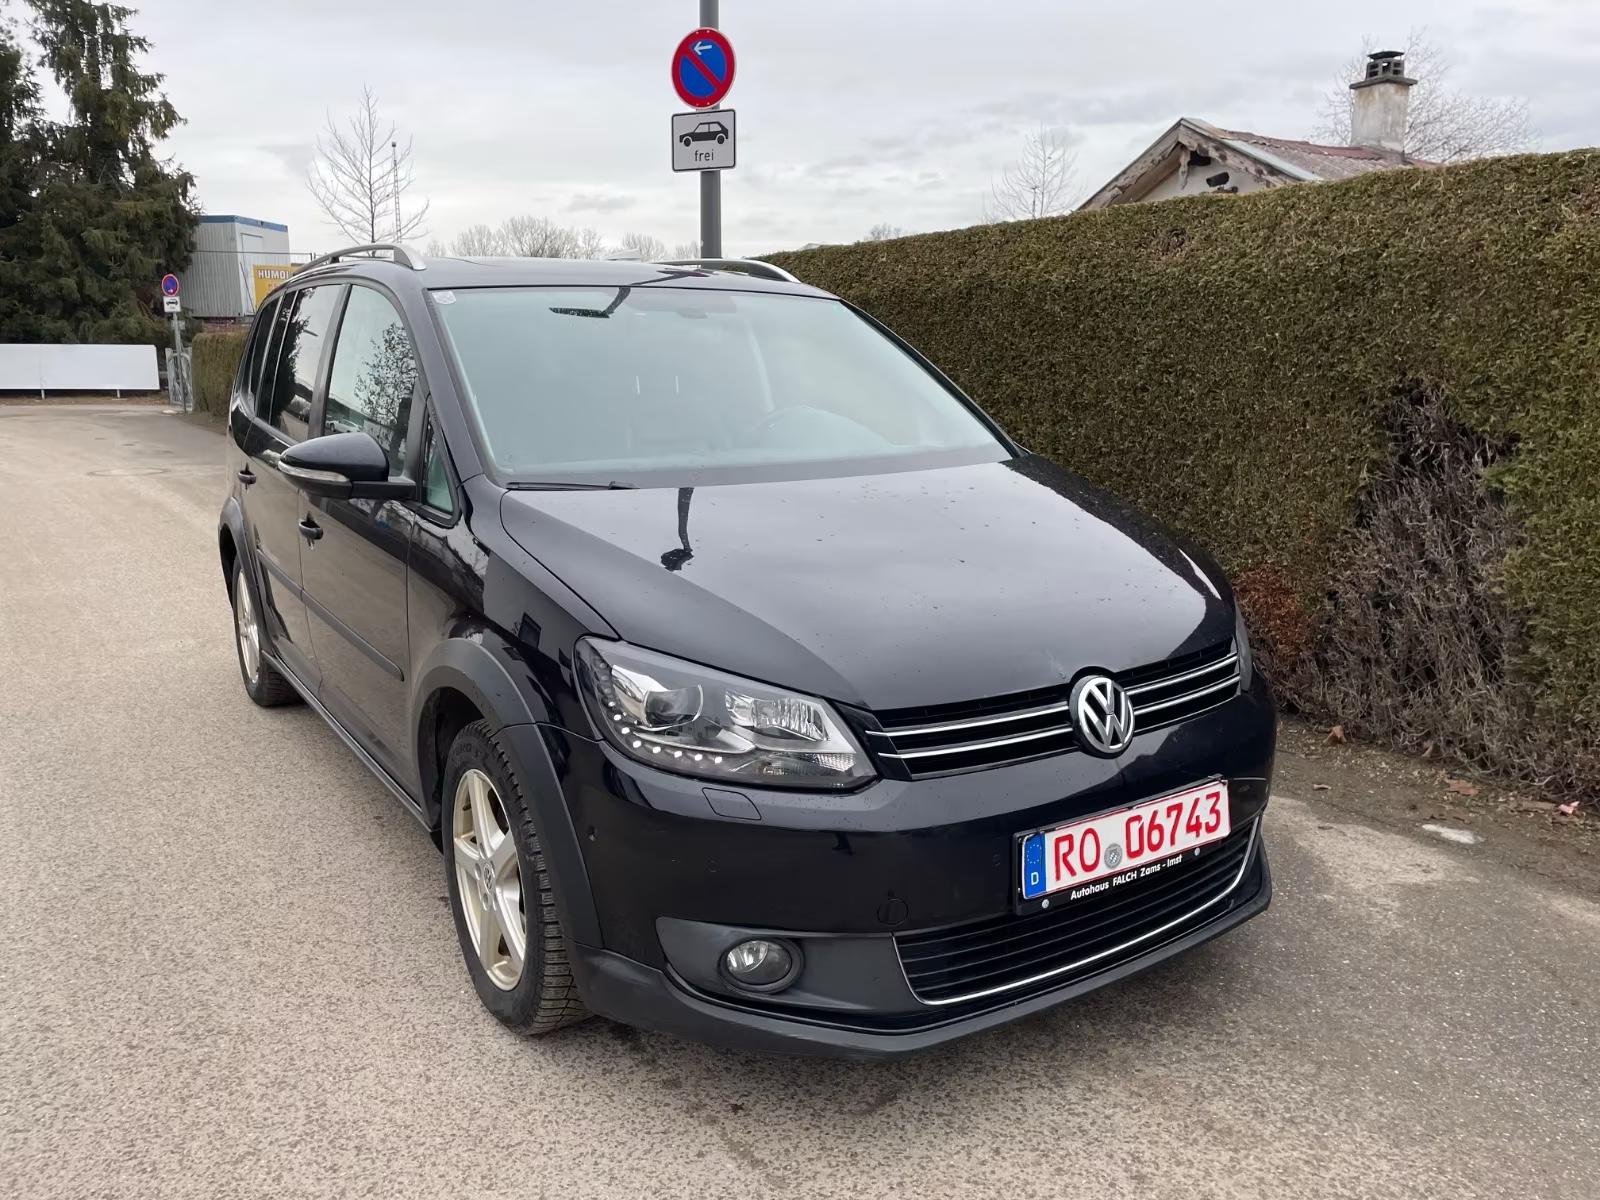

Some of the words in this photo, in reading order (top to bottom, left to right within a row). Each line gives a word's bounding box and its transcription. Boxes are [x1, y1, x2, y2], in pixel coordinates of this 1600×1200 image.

[694, 149, 714, 162] frei
[1079, 677, 1133, 750] VW
[1054, 827, 1101, 881] RO
[1125, 790, 1221, 859] 06743
[1030, 871, 1040, 886] D
[1070, 881, 1110, 900] Autohaus
[1112, 870, 1138, 886] FALCH
[1140, 863, 1161, 878] Zams
[1167, 854, 1183, 868] Imst
